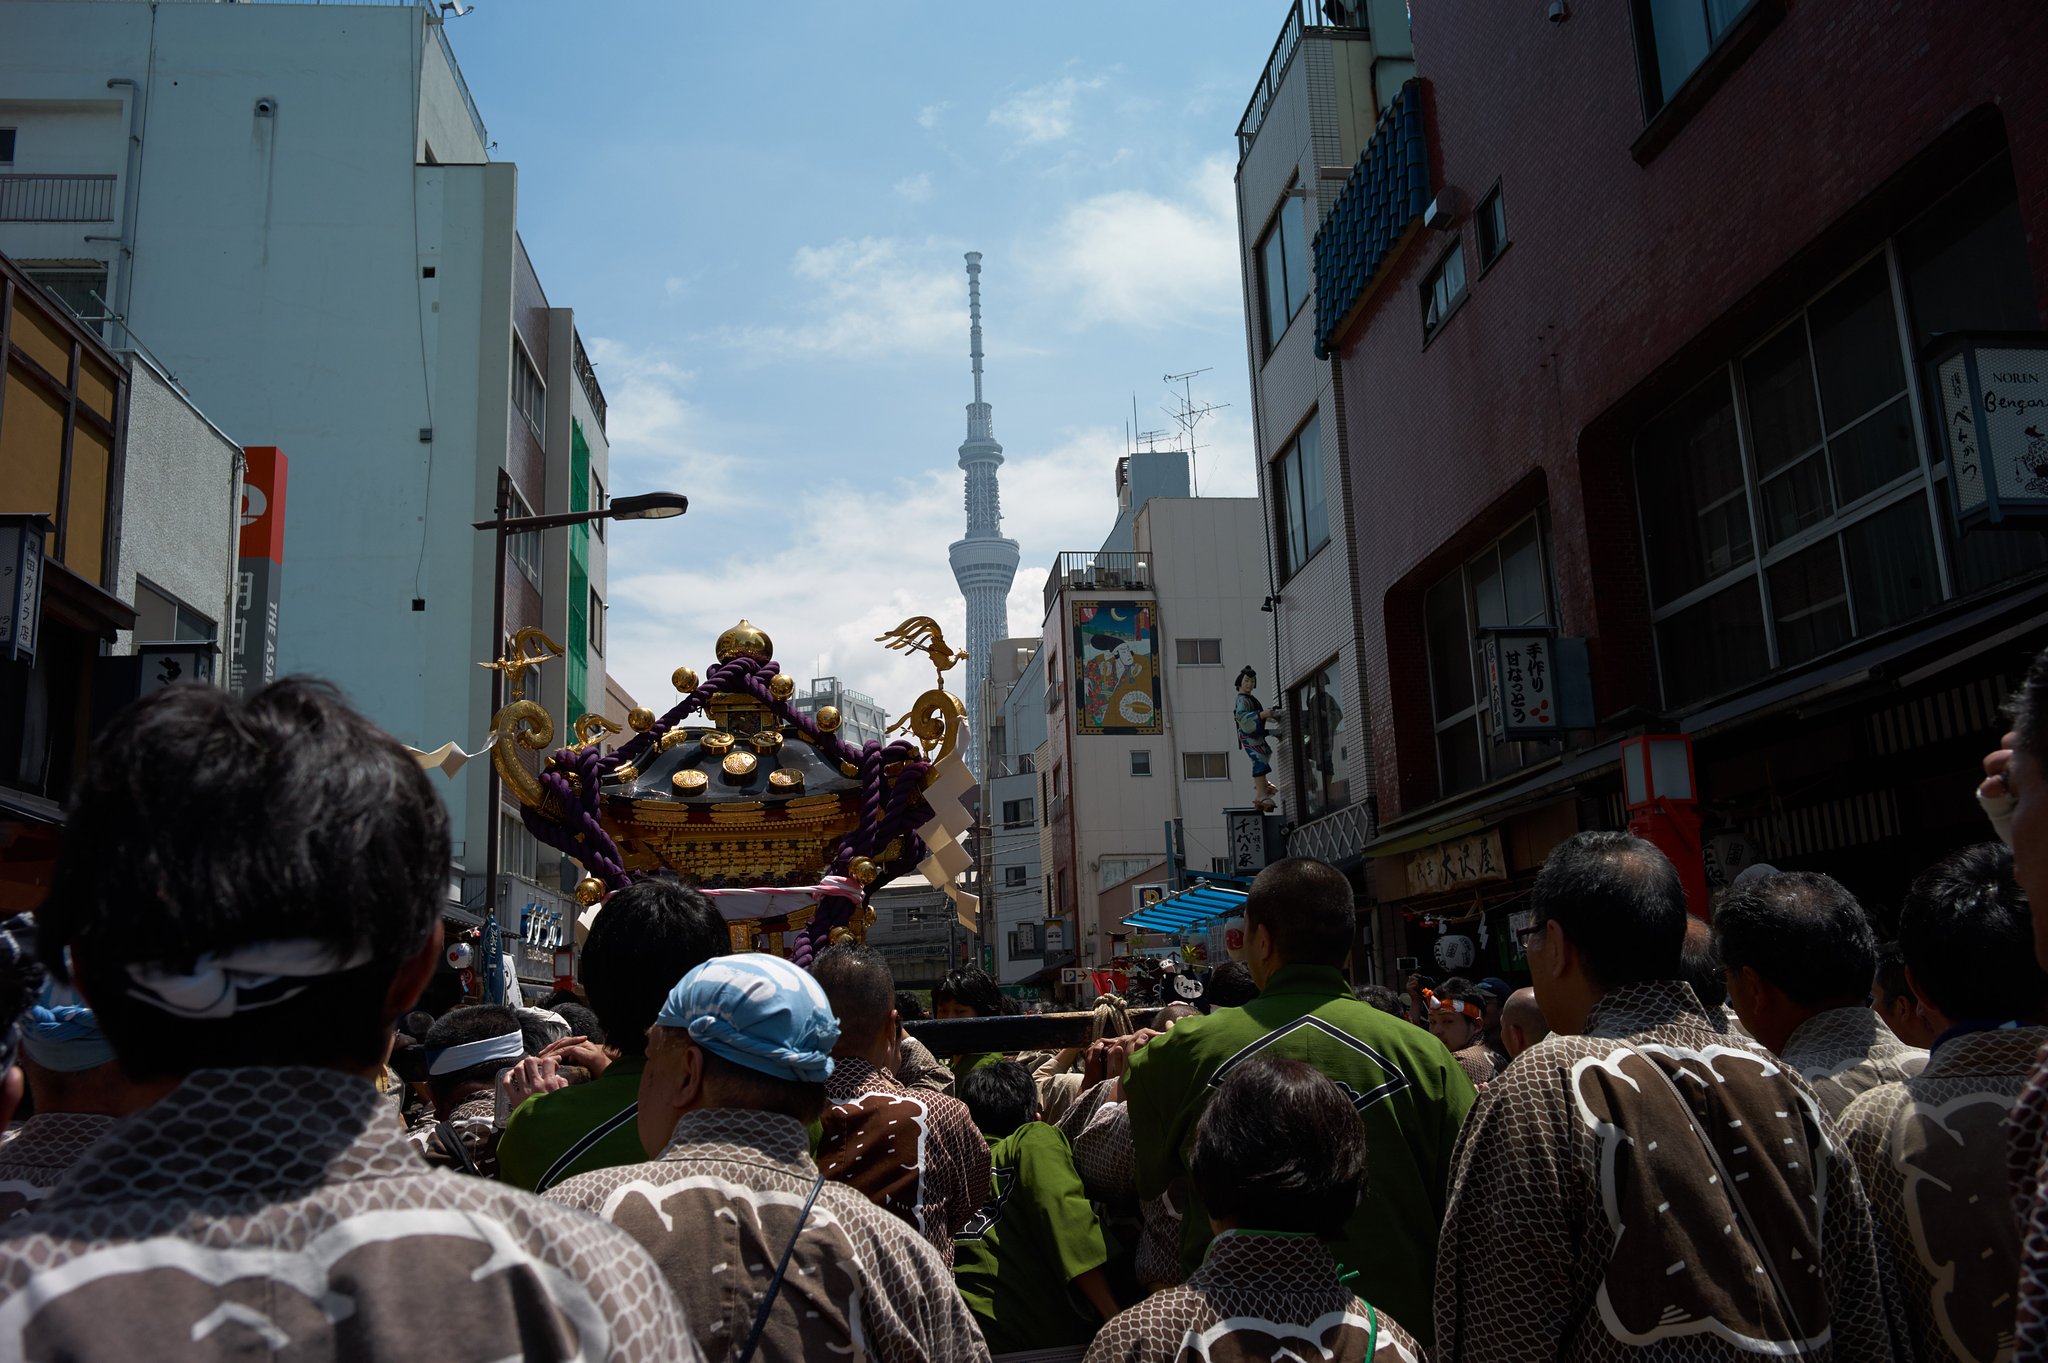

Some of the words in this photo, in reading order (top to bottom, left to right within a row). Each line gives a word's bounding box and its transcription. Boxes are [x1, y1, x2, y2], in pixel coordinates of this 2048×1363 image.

[1993, 372, 2039, 384] NOREN
[268, 601, 278, 636] THE
[1527, 642, 1545, 693] 手作り
[1442, 838, 1496, 885] 大沢屋
